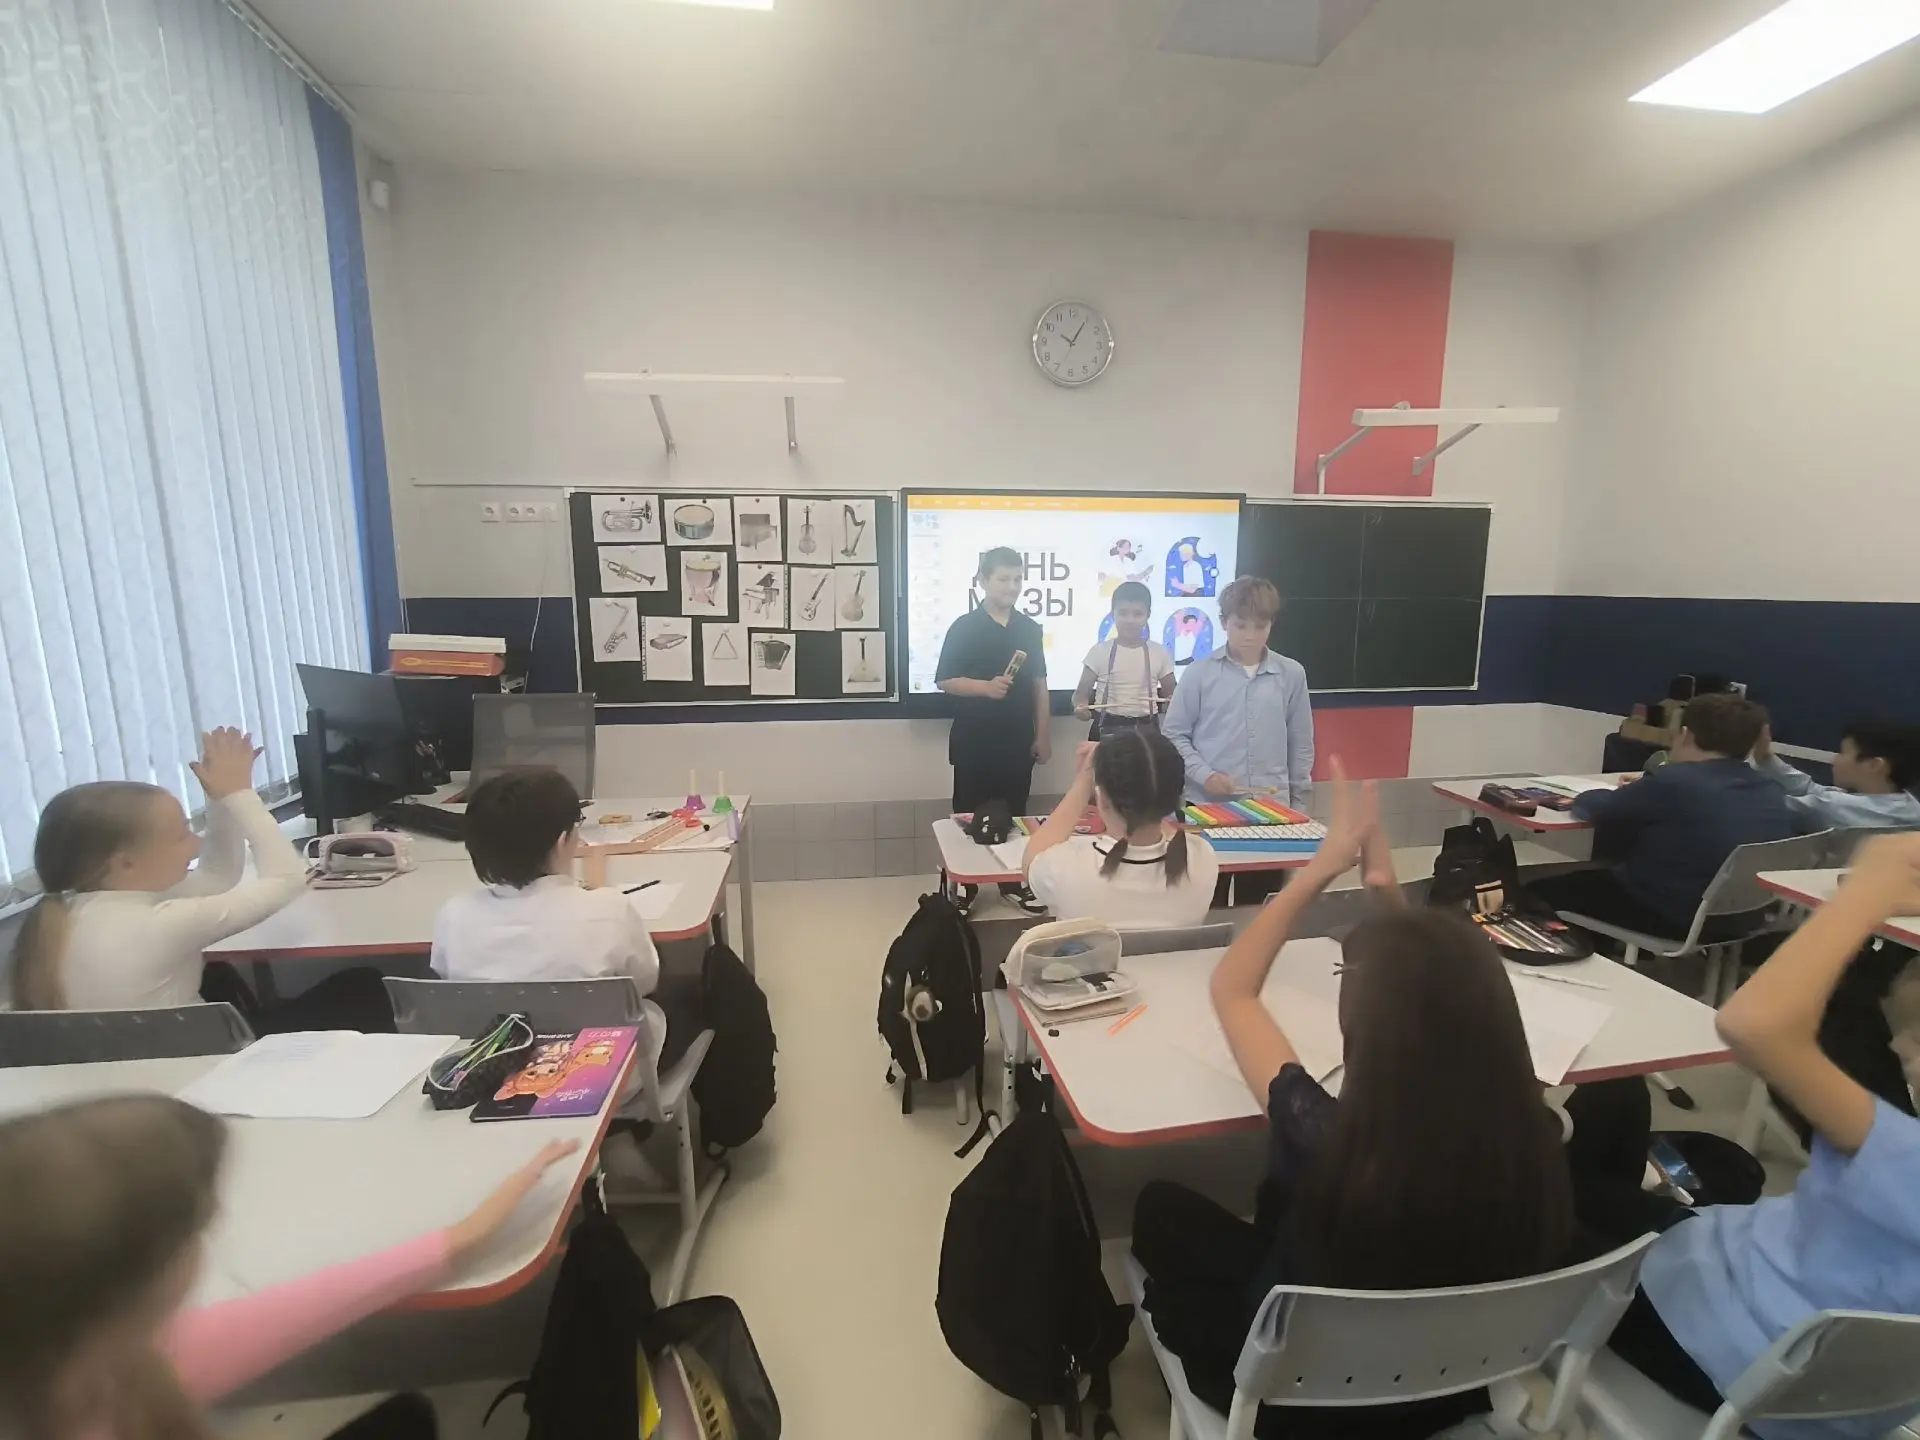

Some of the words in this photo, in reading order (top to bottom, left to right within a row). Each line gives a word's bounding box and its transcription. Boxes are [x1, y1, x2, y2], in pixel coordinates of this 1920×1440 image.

[1046, 323, 1055, 333] 10
[1041, 337, 1048, 346] 9
[1044, 352, 1050, 362] 8
[1053, 362, 1061, 373] 7
[1081, 365, 1089, 376] 5
[1067, 368, 1074, 378] 6
[972, 552, 1070, 588] НЬ
[968, 588, 1073, 617] МЗЫ
